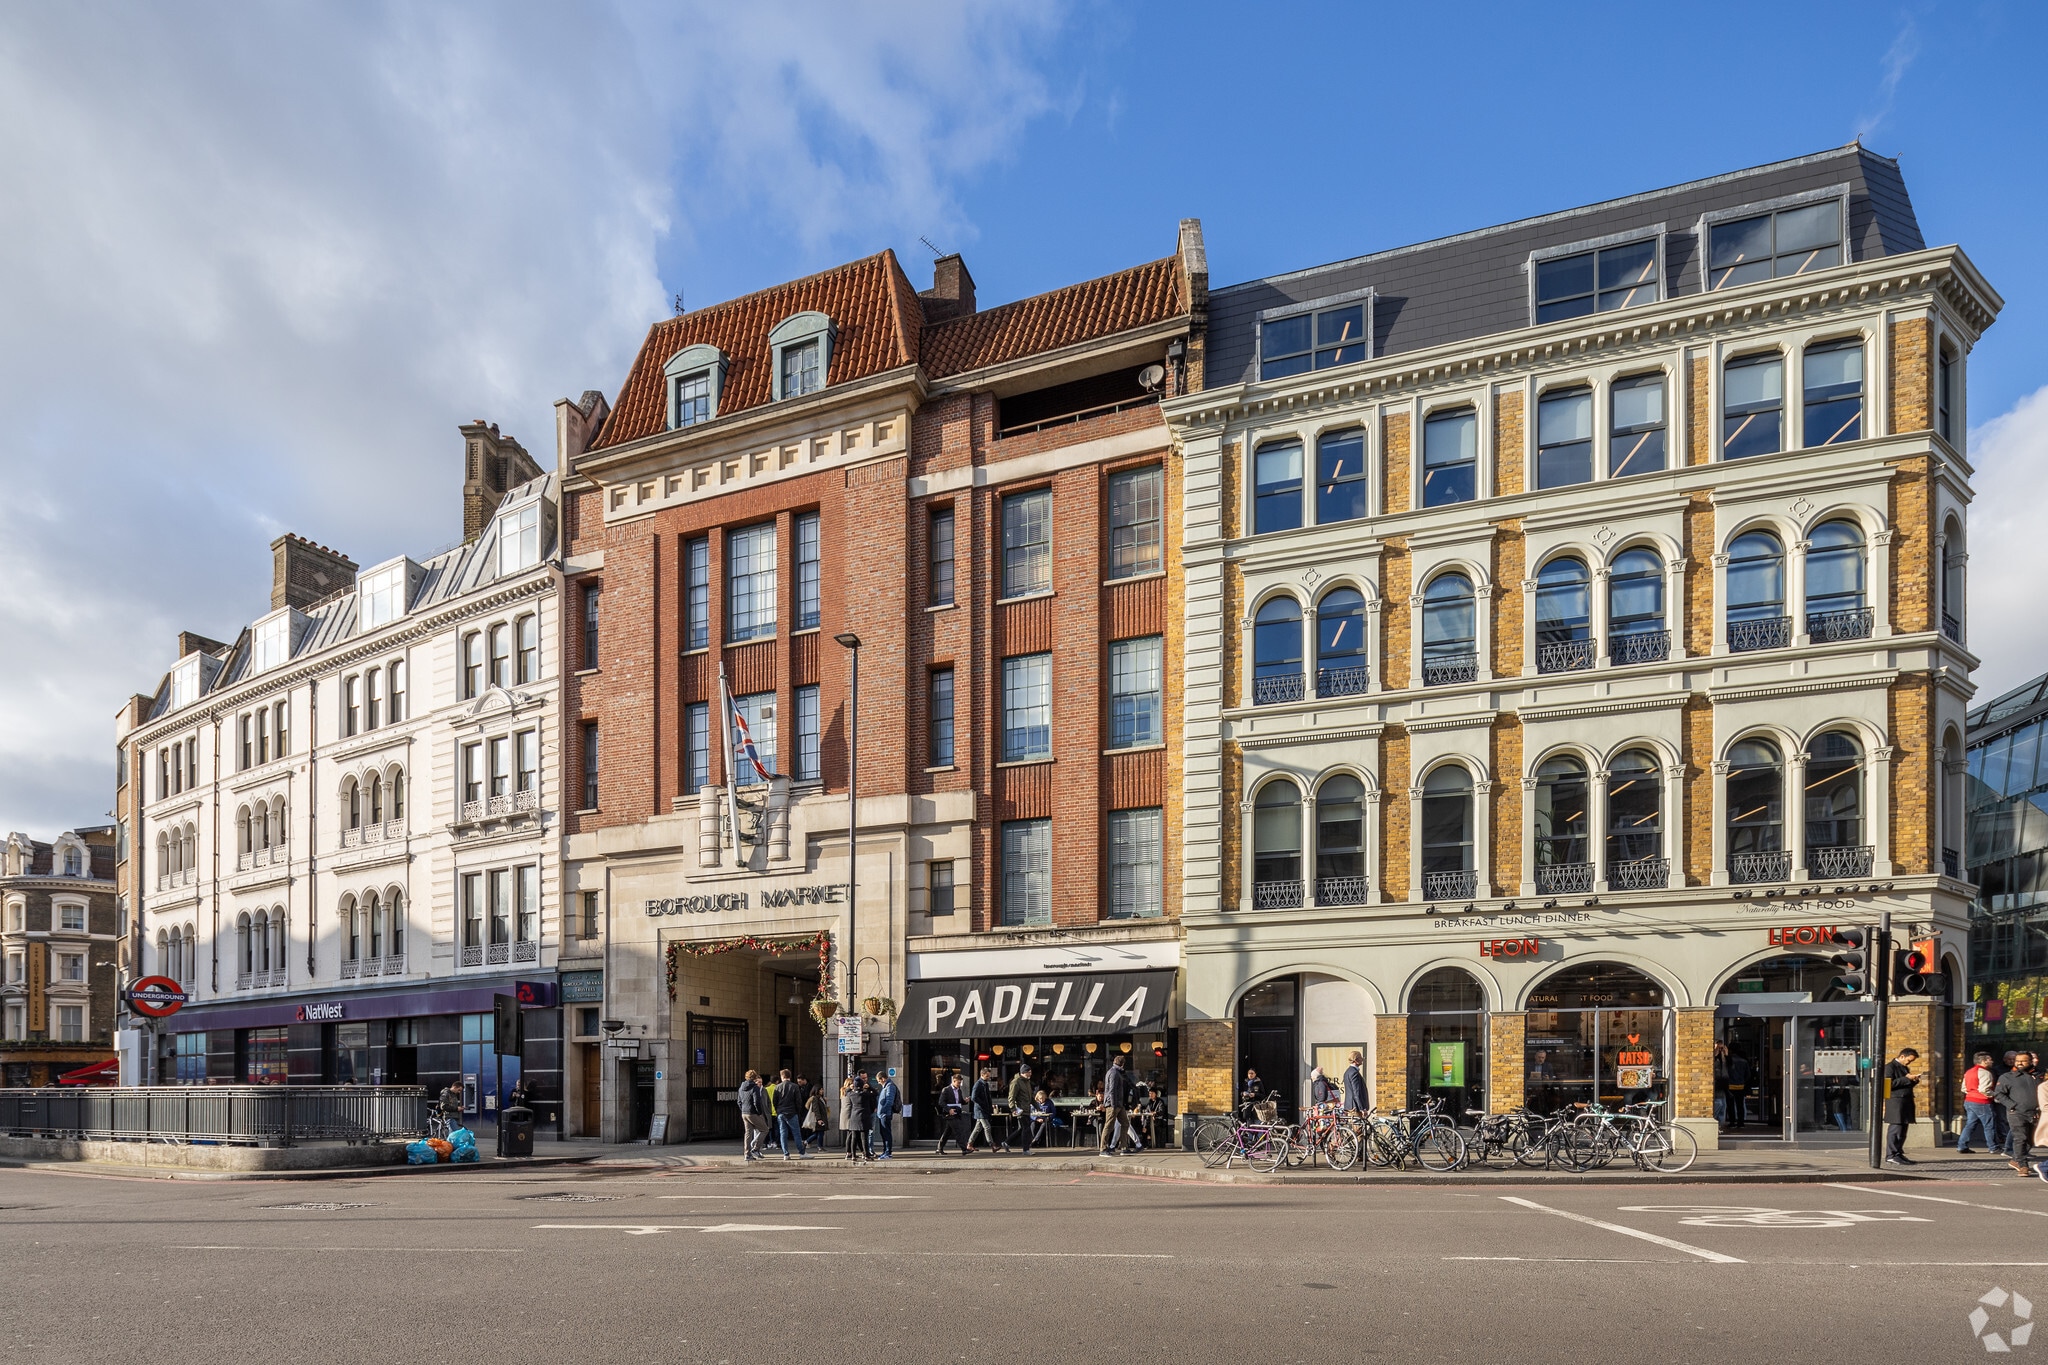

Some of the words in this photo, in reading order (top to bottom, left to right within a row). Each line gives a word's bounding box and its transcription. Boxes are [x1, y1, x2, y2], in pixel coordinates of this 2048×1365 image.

[645, 892, 749, 917] BOROUGH
[1736, 904, 1779, 916] Naturally
[1783, 902, 1812, 911] FAST
[1817, 900, 1855, 910] FOOD
[1434, 918, 1495, 928] BREAKFAST
[1500, 916, 1541, 925] LUNCH
[1546, 913, 1591, 923] DINNER
[1769, 926, 1837, 945] LEON
[1479, 938, 1539, 957] LEON
[132, 992, 185, 1000] UNDERGROUND
[1590, 994, 1613, 1002] FOOD
[305, 1002, 343, 1020] NatWest
[928, 981, 1148, 1034] PADELLA
